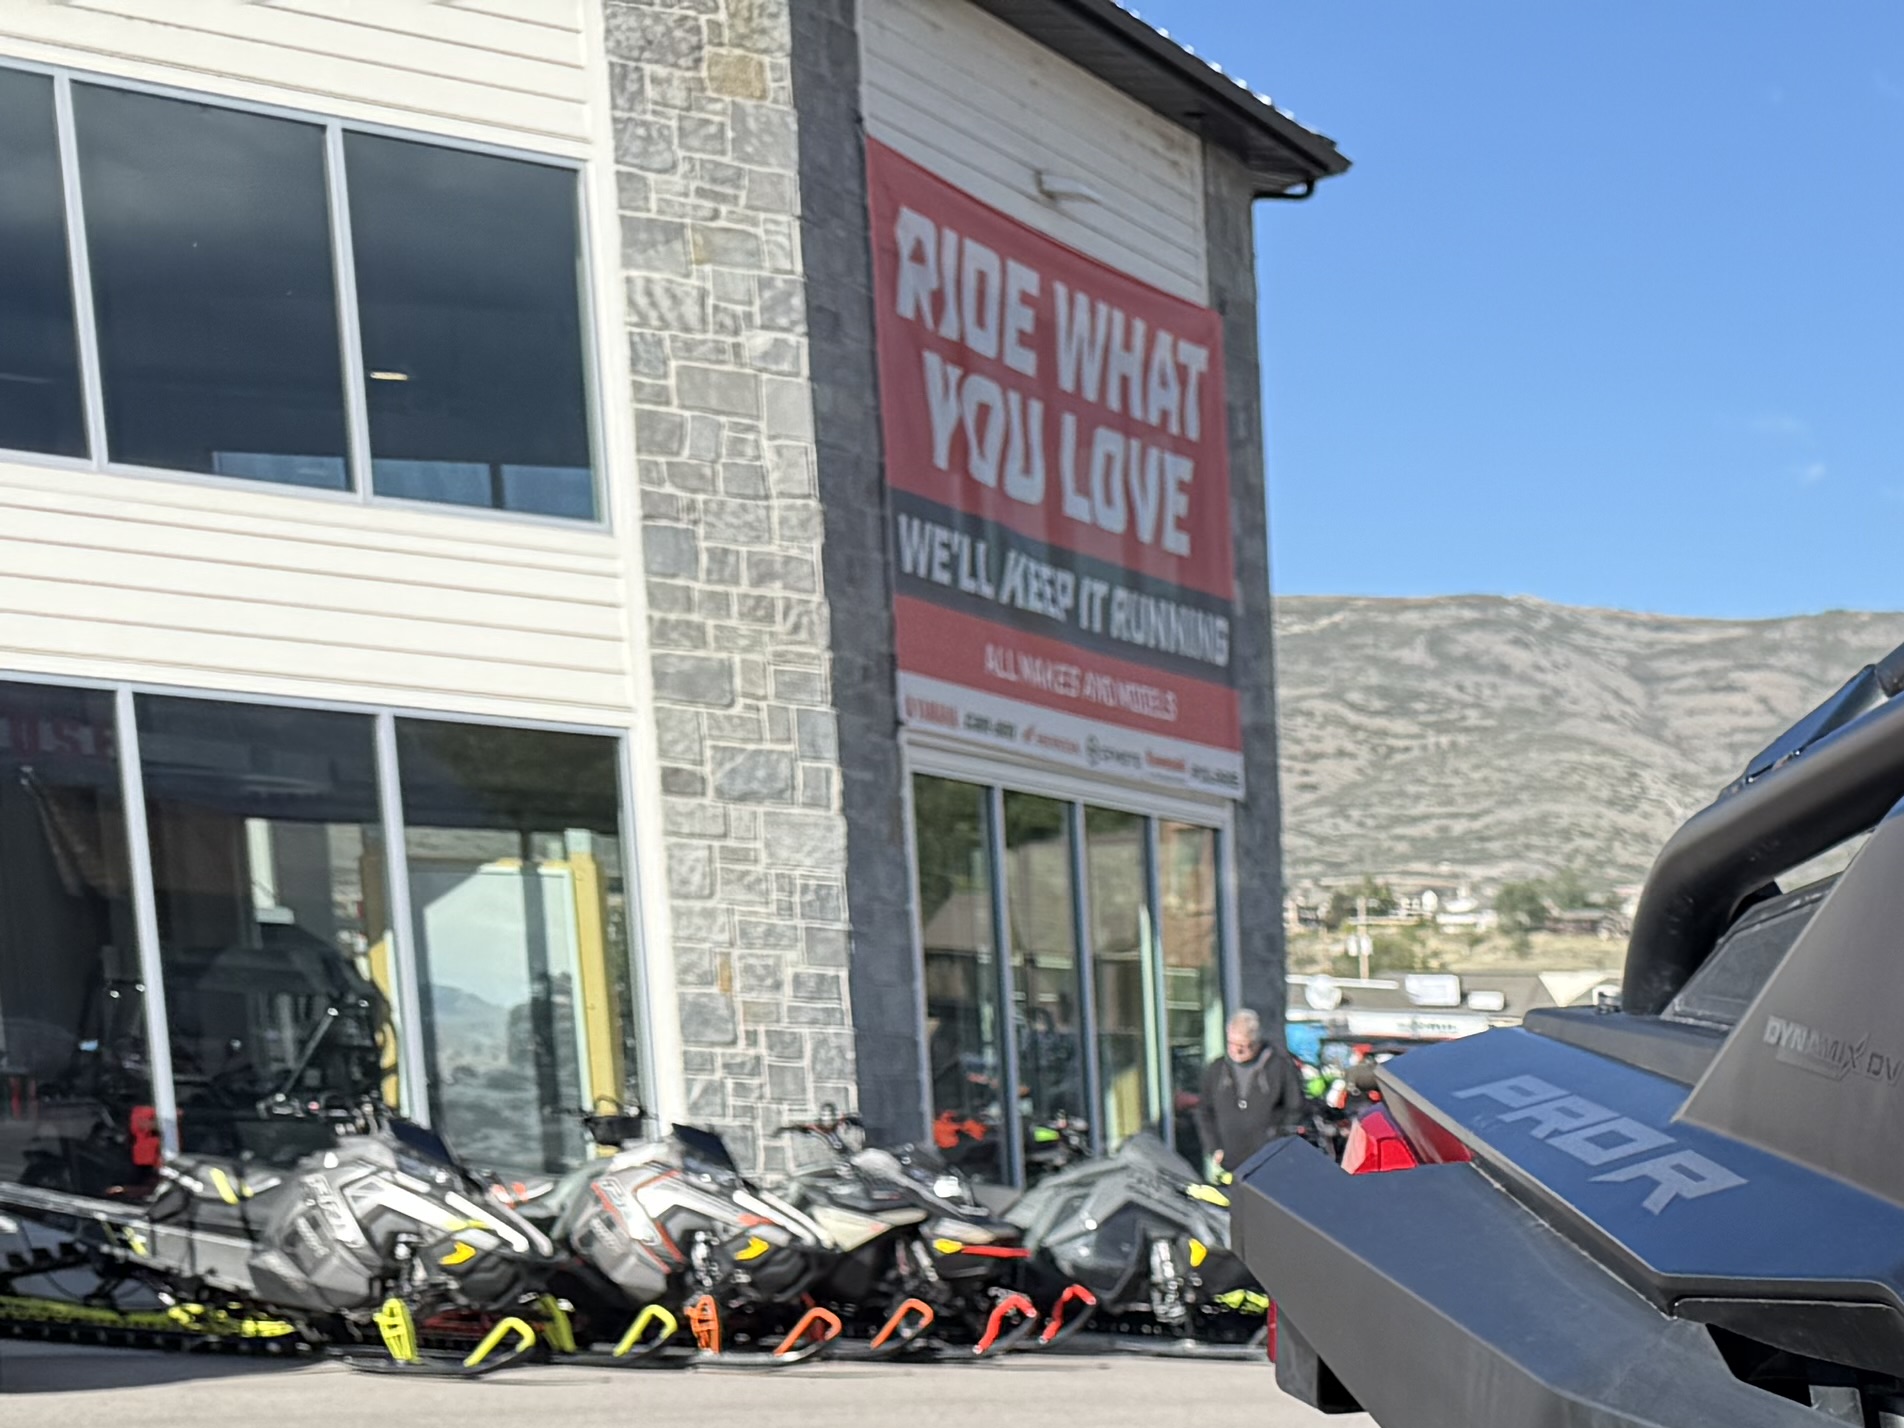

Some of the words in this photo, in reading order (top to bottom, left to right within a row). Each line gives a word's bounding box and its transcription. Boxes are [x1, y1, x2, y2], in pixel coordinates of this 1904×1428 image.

[894, 206, 1041, 379] RIDE
[1052, 280, 1209, 443] WHAT
[922, 347, 1045, 505] YOU
[1060, 411, 1195, 558] LOVE
[899, 512, 996, 600] WE'LL
[999, 549, 1076, 622] KEEP
[1078, 576, 1111, 634] IT
[1109, 584, 1230, 668] RUNNING
[985, 643, 1018, 682] ALL
[1019, 652, 1082, 698] MAKES
[1083, 671, 1117, 707] AND
[1118, 678, 1178, 722] MODELS
[1763, 1015, 1868, 1075] DYNAMIX
[1451, 1075, 1677, 1165] PRO
[1588, 1149, 1749, 1216] R
